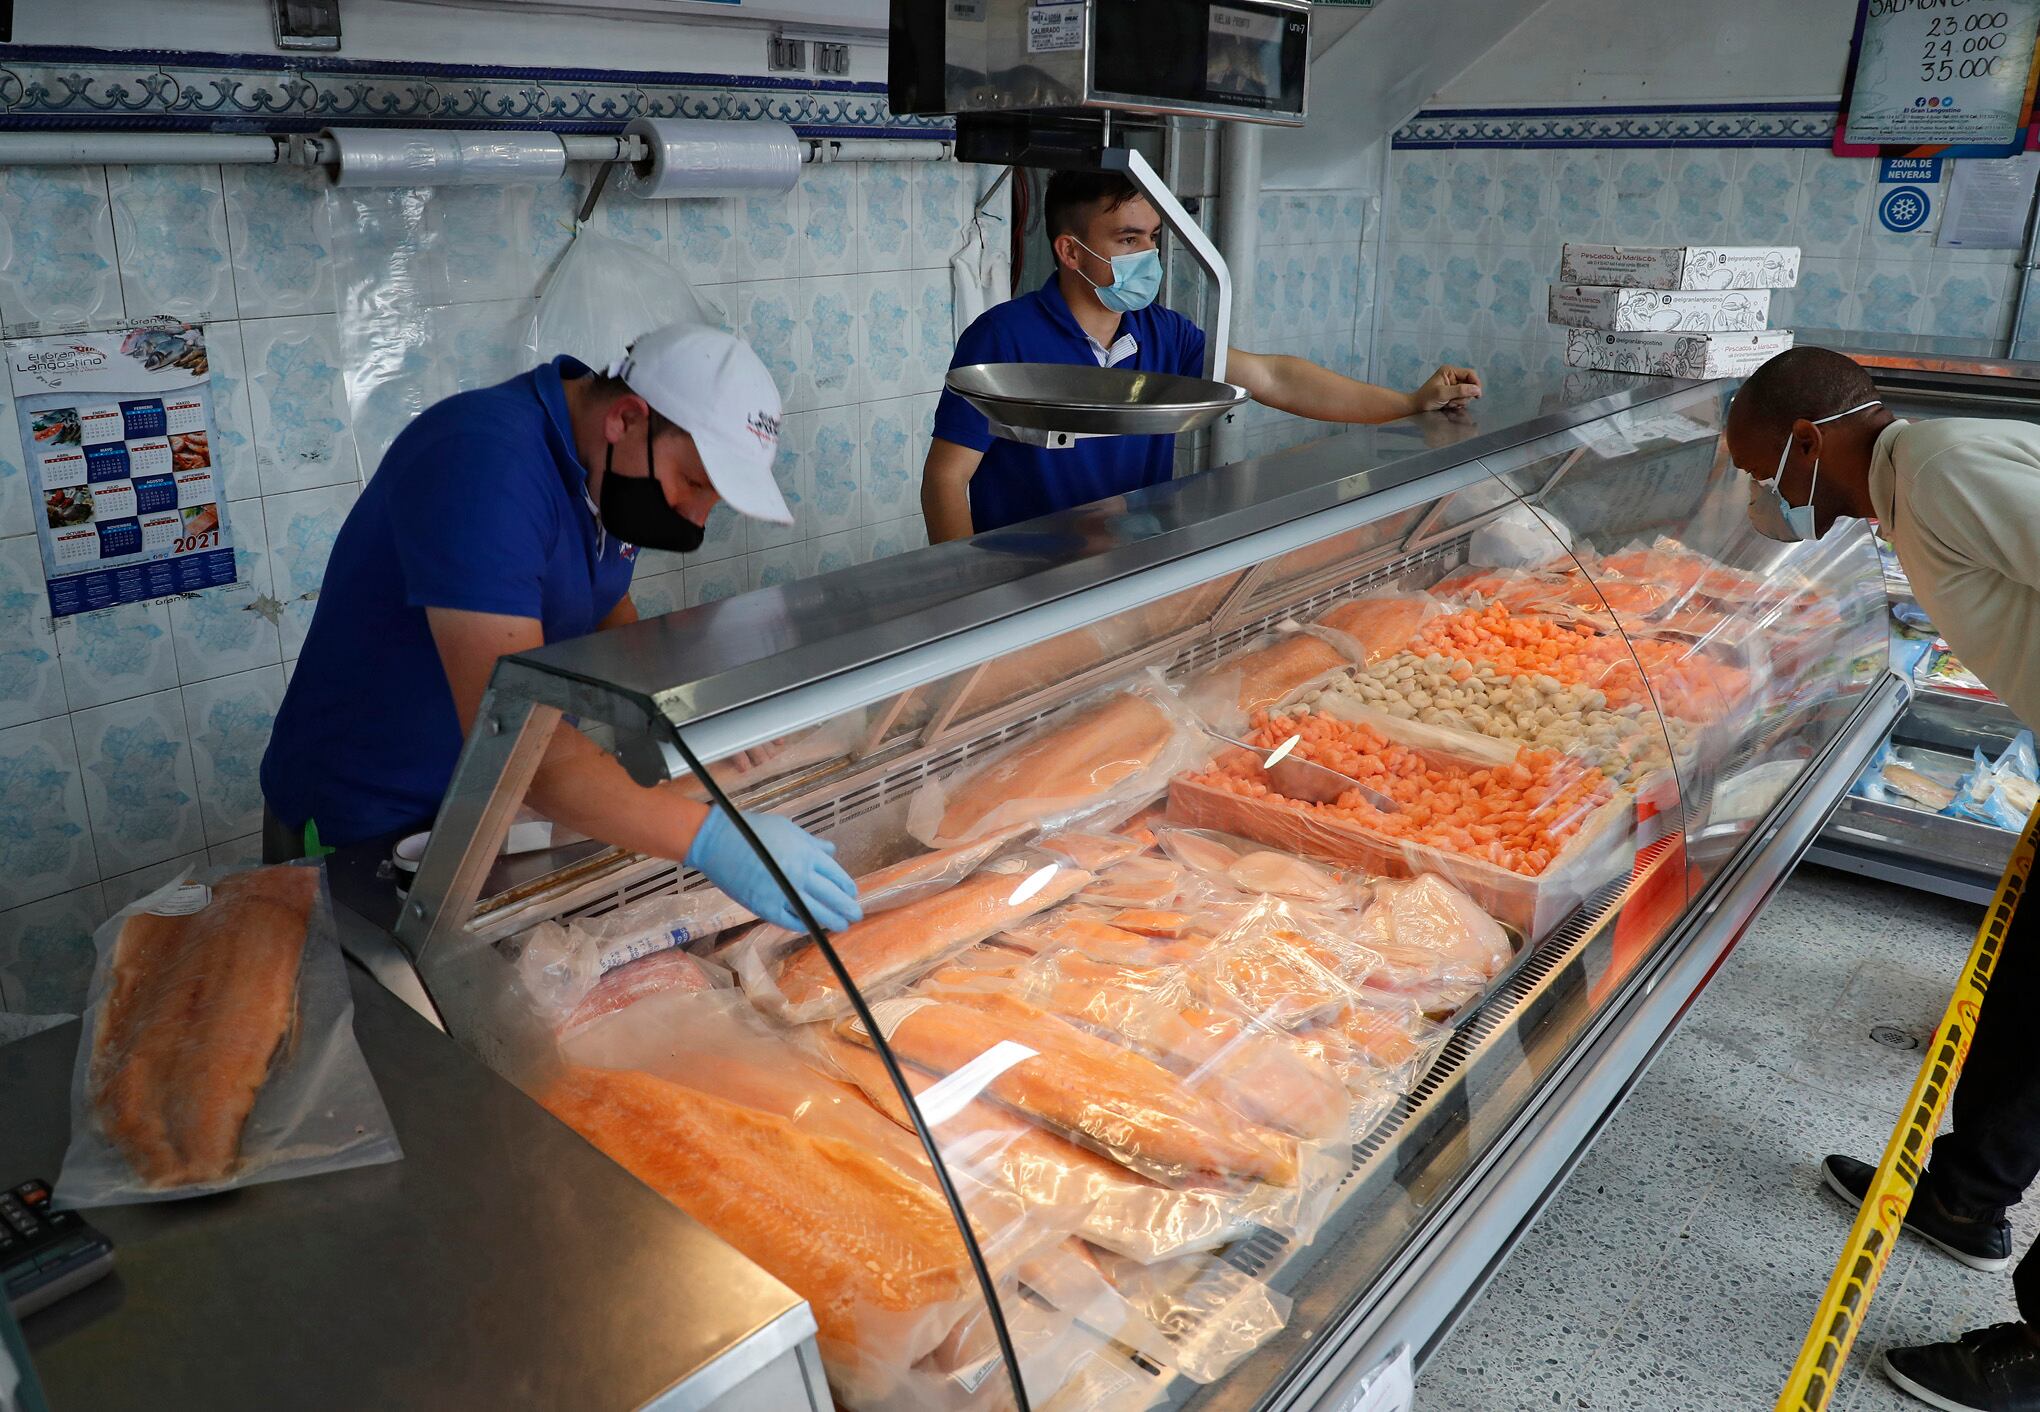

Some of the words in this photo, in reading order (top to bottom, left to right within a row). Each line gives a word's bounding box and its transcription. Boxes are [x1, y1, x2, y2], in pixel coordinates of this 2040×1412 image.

[1031, 26, 1060, 35] CALIBRADO
[1926, 12, 2008, 37] 23.000
[1922, 32, 2007, 59] 24.000
[1921, 56, 2002, 82] 35.000
[1890, 159, 1917, 168] ZONA
[1920, 159, 1932, 168] DE
[1888, 170, 1932, 179] NEVERAS
[1580, 252, 1614, 260] Pescados
[45, 351, 76, 360] Gran
[16, 357, 102, 372] Langostino
[174, 531, 220, 554] 2021
